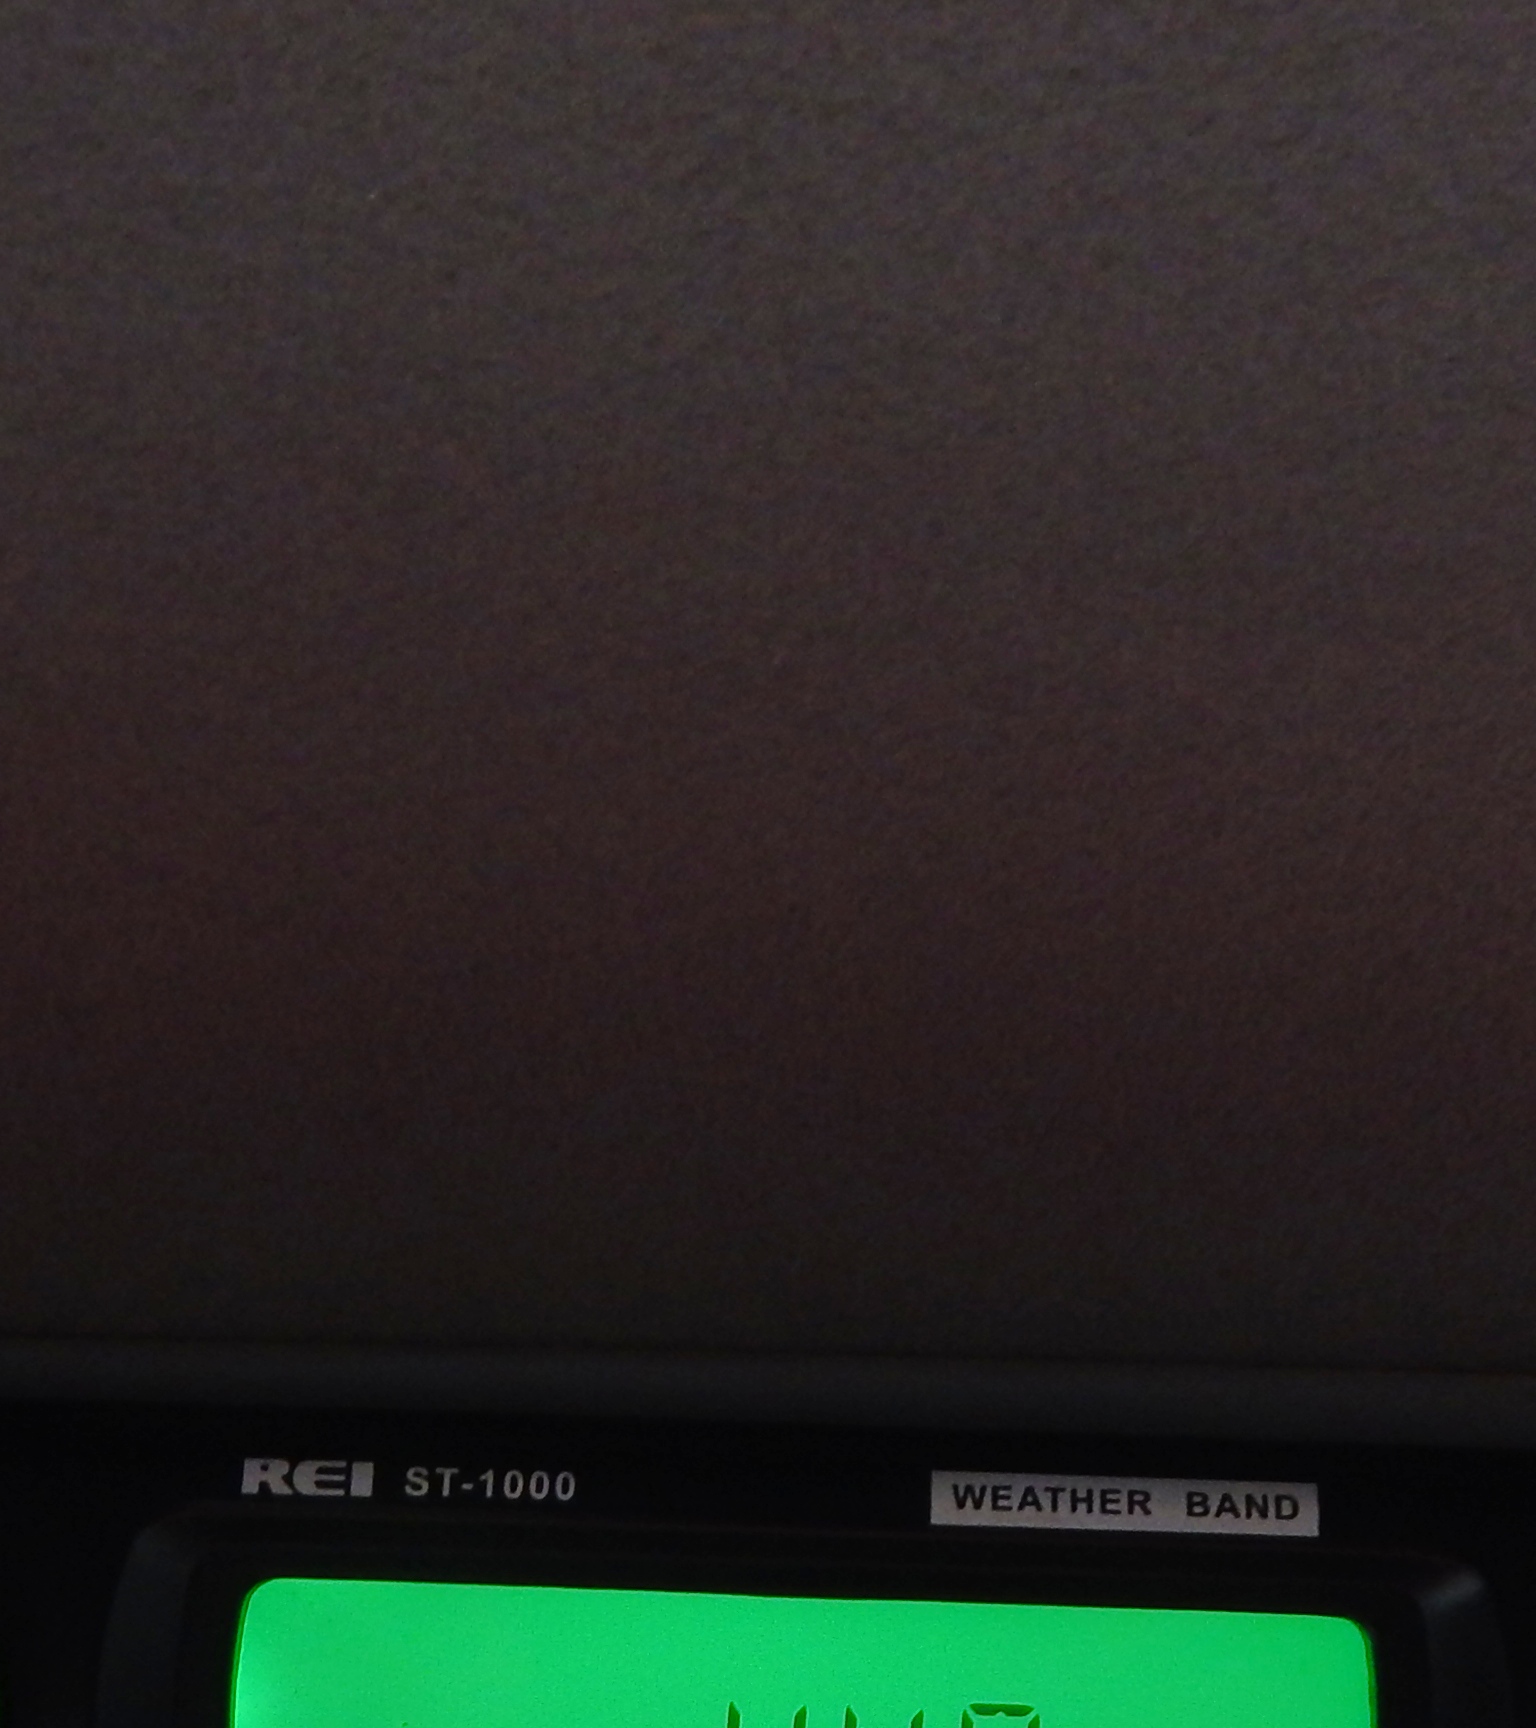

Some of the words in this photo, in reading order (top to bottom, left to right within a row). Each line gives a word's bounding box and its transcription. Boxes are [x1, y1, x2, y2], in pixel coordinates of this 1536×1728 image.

[241, 1458, 375, 1498] REI
[404, 1466, 576, 1502] ST-1000
[951, 1482, 1153, 1516] WEATHER
[1185, 1489, 1301, 1521] BAND
